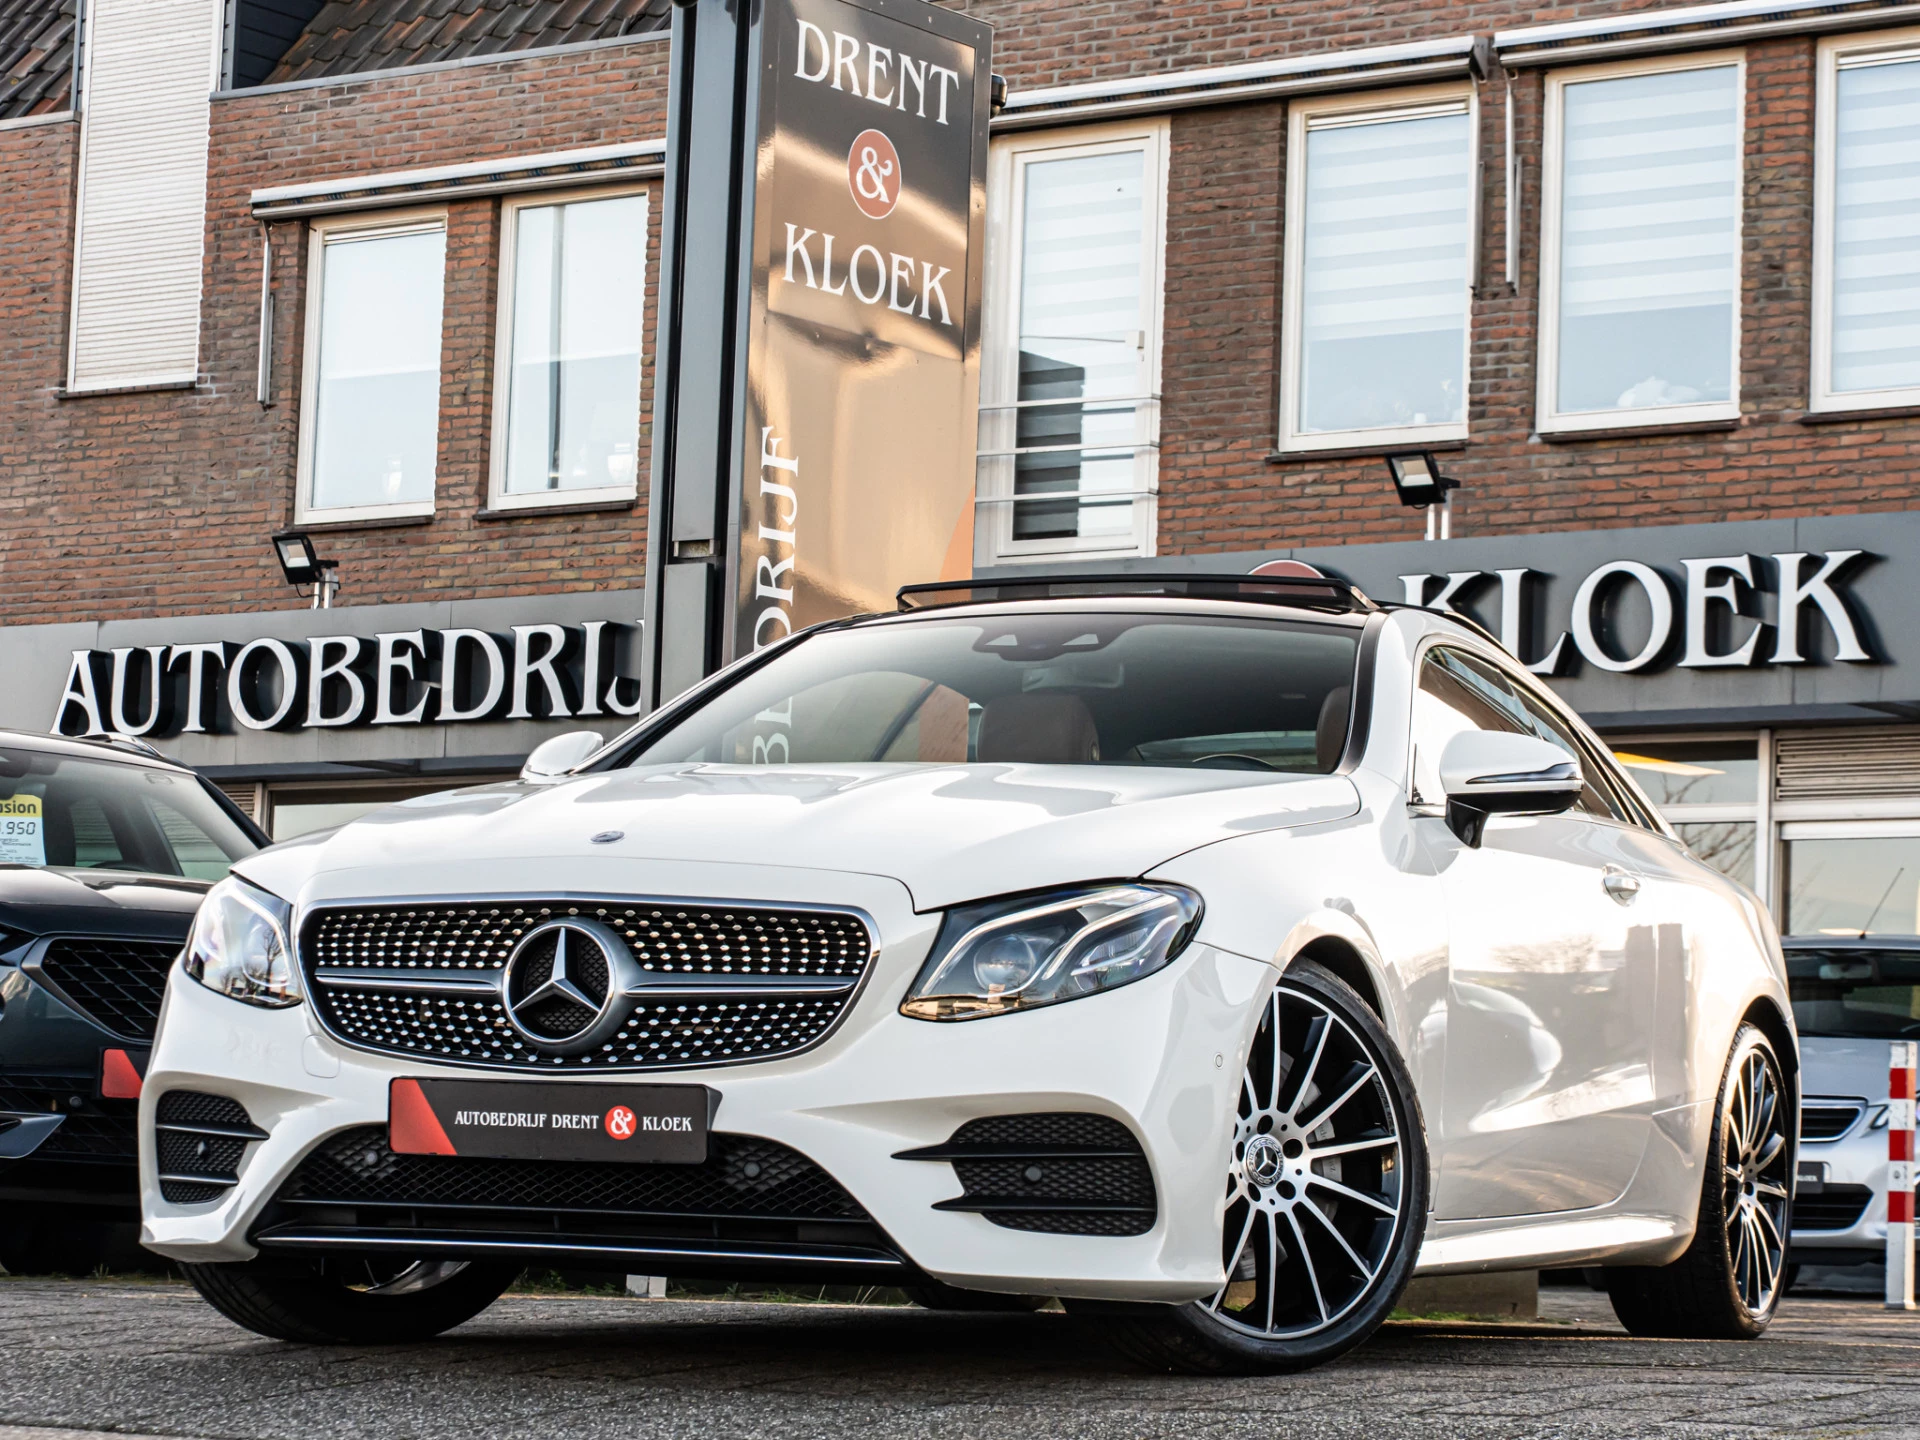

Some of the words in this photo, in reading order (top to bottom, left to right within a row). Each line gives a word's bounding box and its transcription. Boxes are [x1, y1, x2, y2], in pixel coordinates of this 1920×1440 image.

[793, 18, 959, 126] DRENT
[855, 145, 893, 204] &
[782, 222, 953, 326] KLOEK
[0, 821, 36, 835] .950
[454, 1110, 548, 1128] AUTOBEDRIJF
[551, 1113, 600, 1130] DRENT
[610, 1108, 633, 1135] &
[642, 1116, 693, 1132] KLOEK
